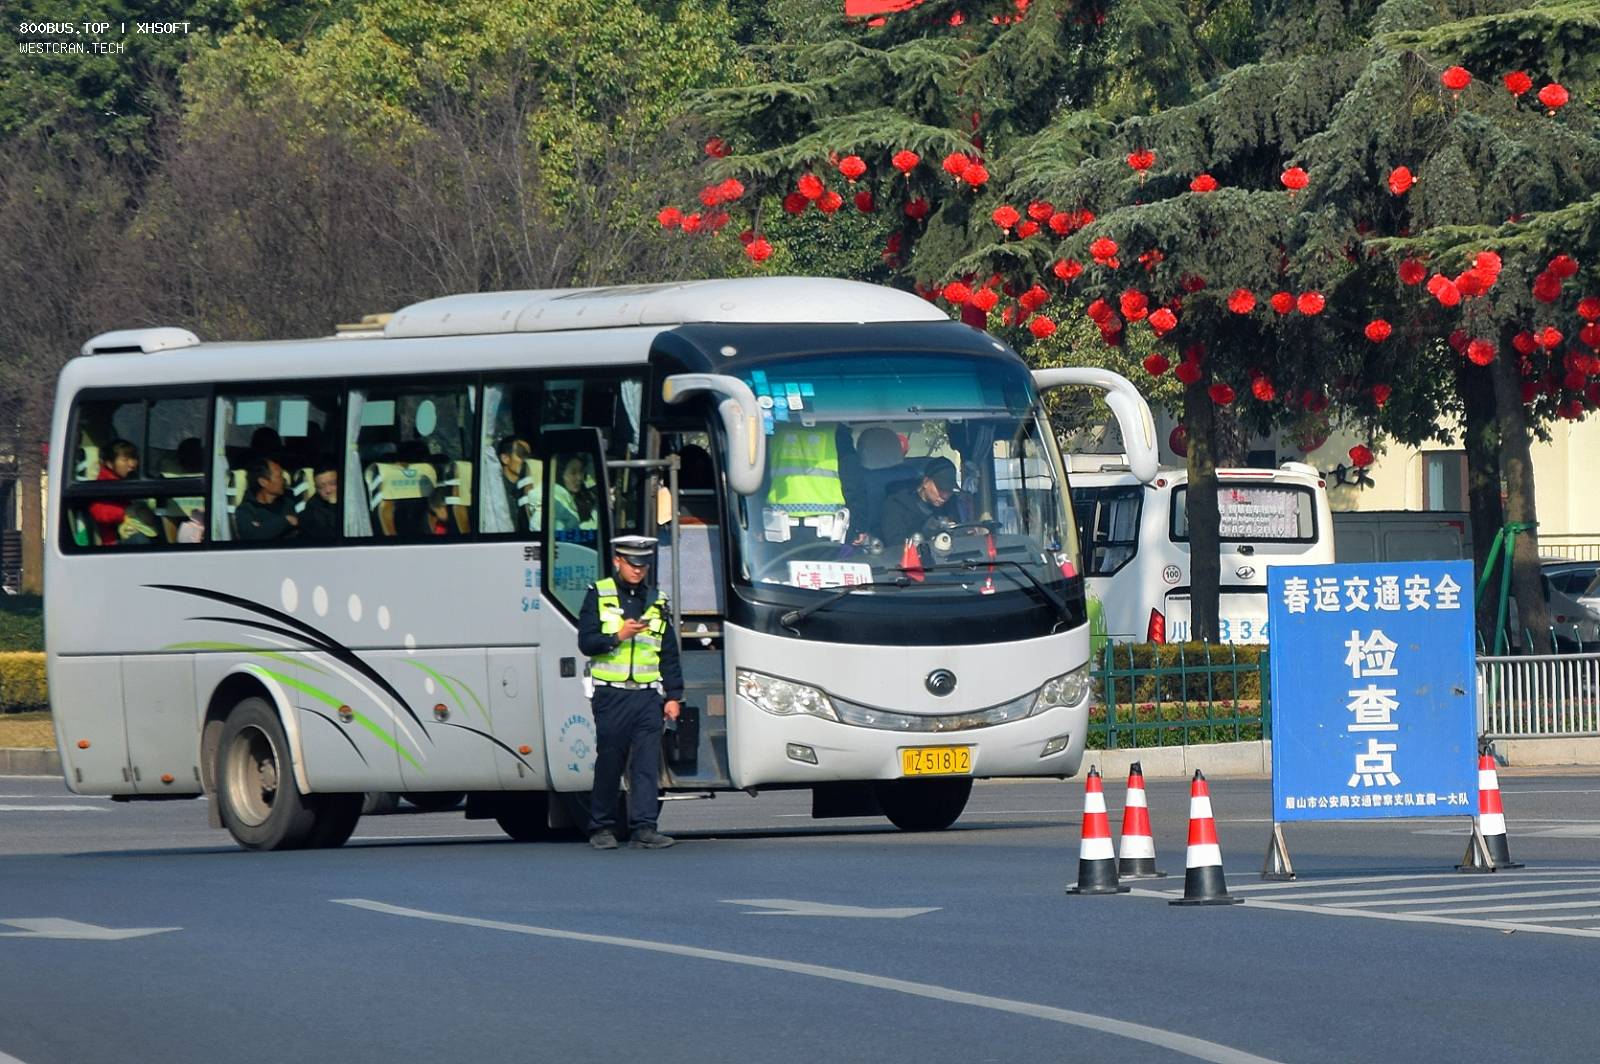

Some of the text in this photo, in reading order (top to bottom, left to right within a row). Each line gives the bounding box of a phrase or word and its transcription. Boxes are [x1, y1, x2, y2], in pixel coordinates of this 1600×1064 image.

[1165, 570, 1179, 579] 100
[1283, 573, 1461, 614] 春运交通安全
[1344, 629, 1401, 788] 检查点
